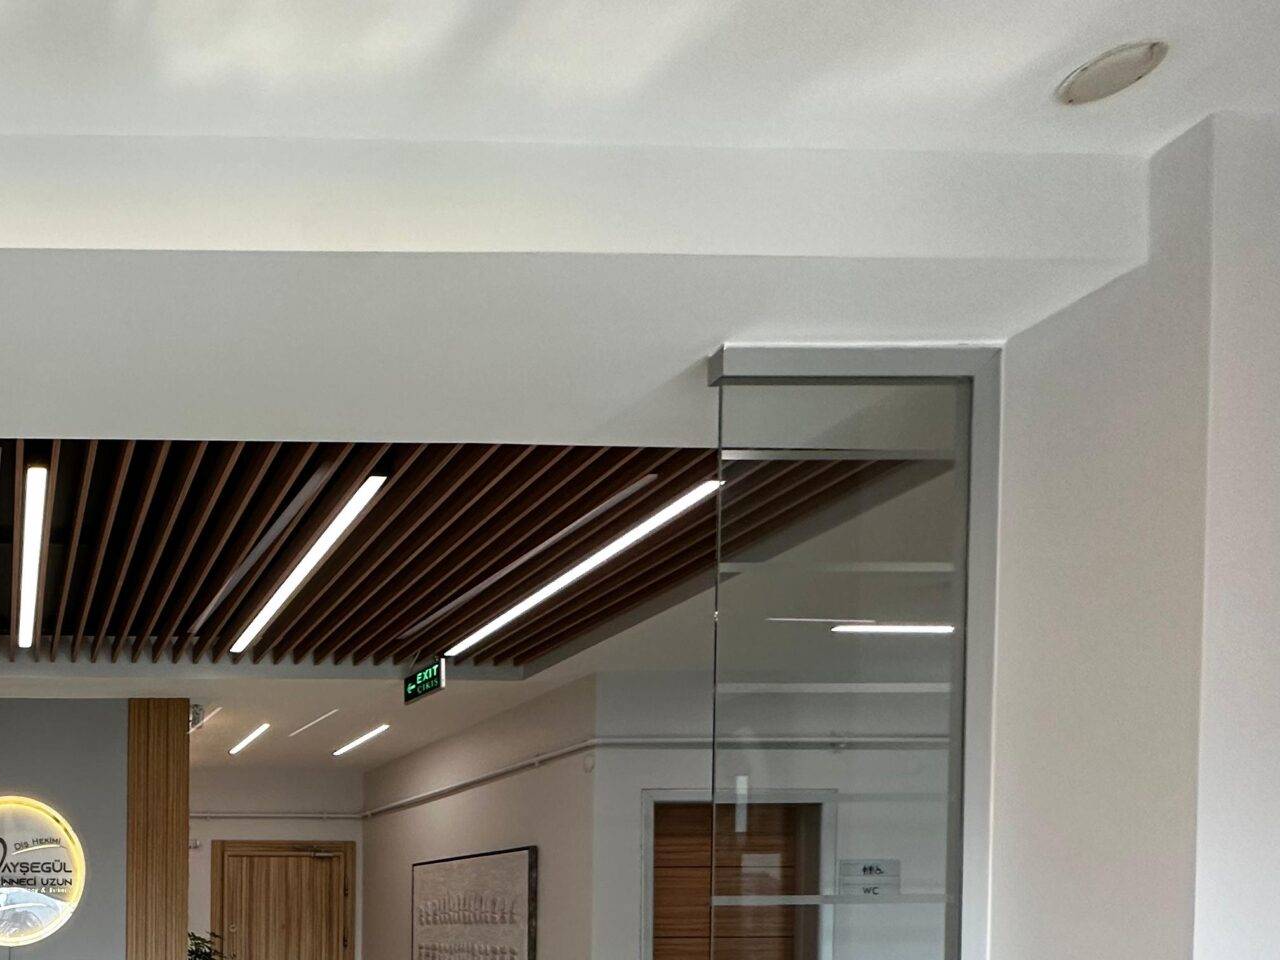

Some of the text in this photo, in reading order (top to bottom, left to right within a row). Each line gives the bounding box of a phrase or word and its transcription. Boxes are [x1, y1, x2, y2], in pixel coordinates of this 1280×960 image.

[416, 664, 439, 684] EXIT
[1, 859, 73, 875] AYŞEGÜL
[41, 877, 73, 886] UZUN
[862, 886, 879, 895] WC
